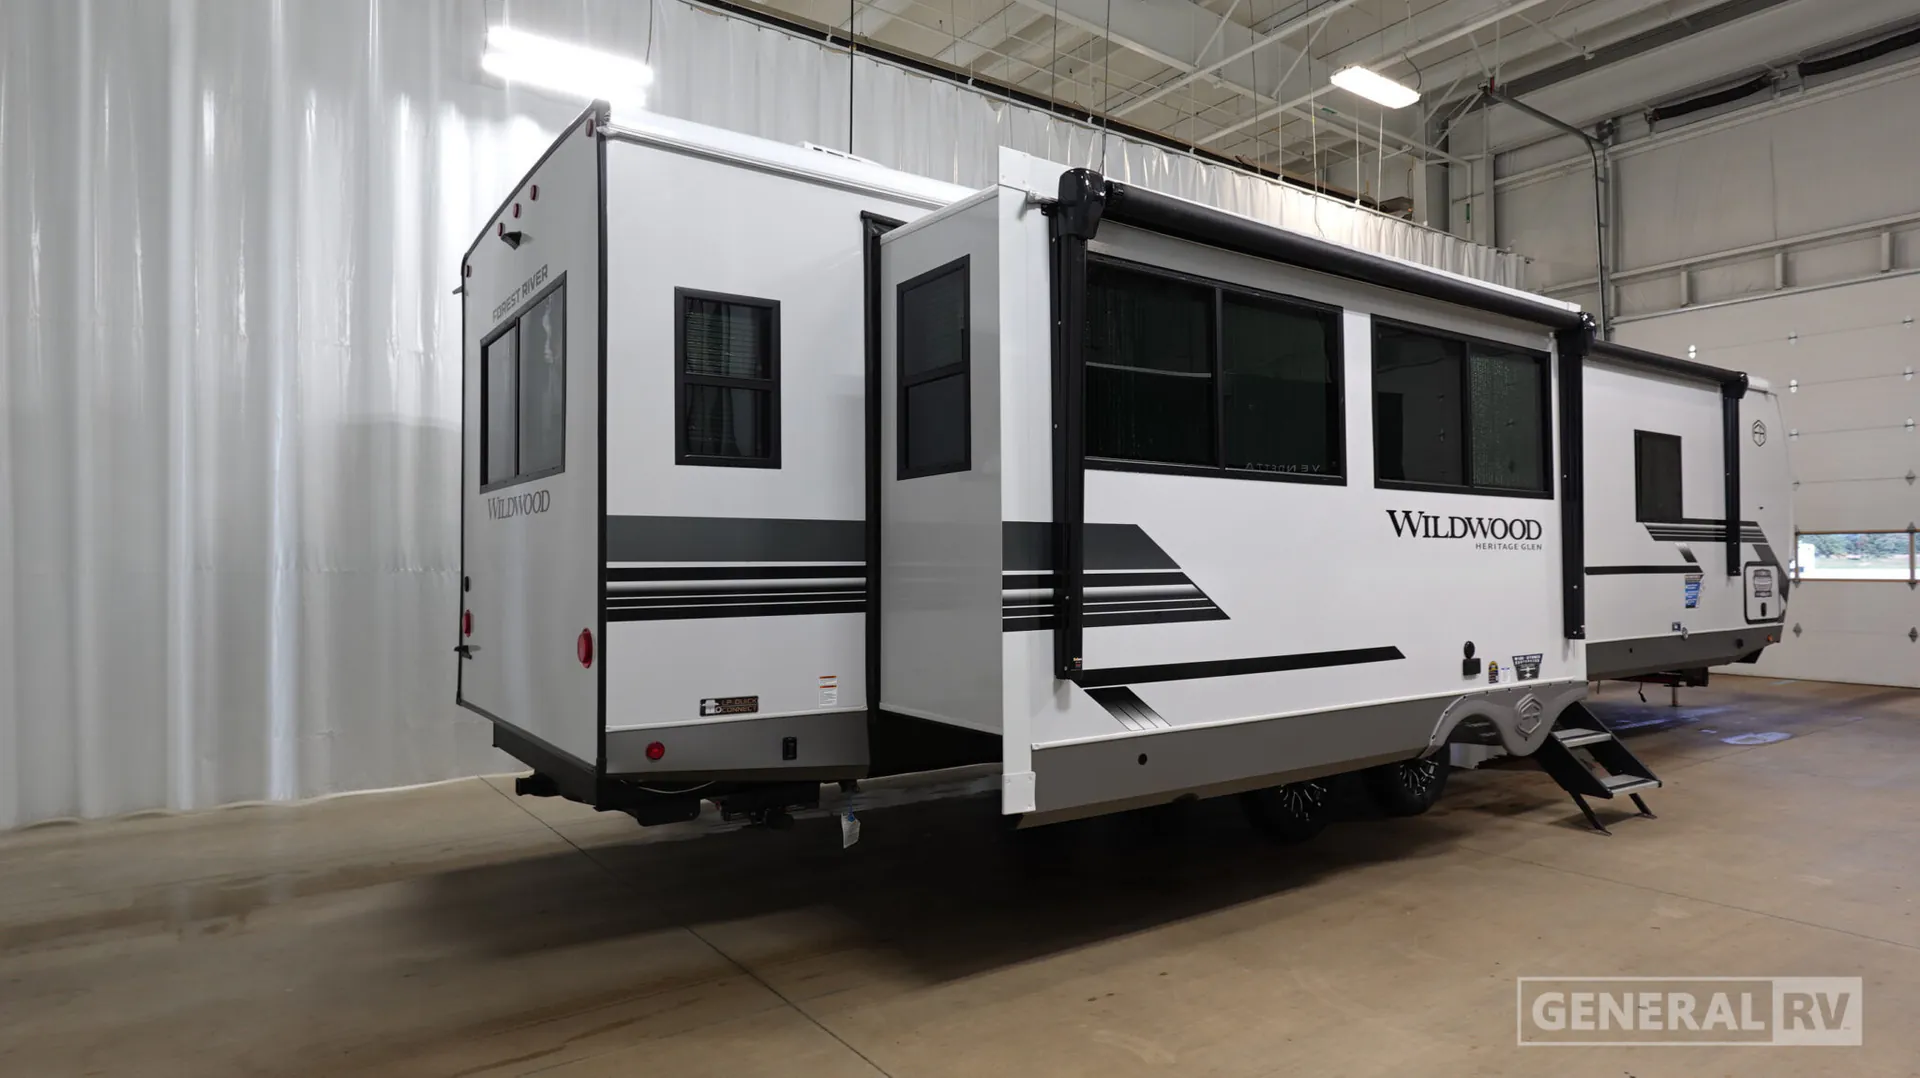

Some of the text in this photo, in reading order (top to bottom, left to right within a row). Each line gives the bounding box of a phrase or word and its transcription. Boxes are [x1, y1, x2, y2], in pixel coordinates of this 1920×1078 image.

[493, 264, 548, 323] FOREST RIVER
[488, 489, 551, 520] WILDWOOD
[1386, 509, 1542, 541] WILDWOOD
[1475, 543, 1543, 551] HERITAGE GLEN
